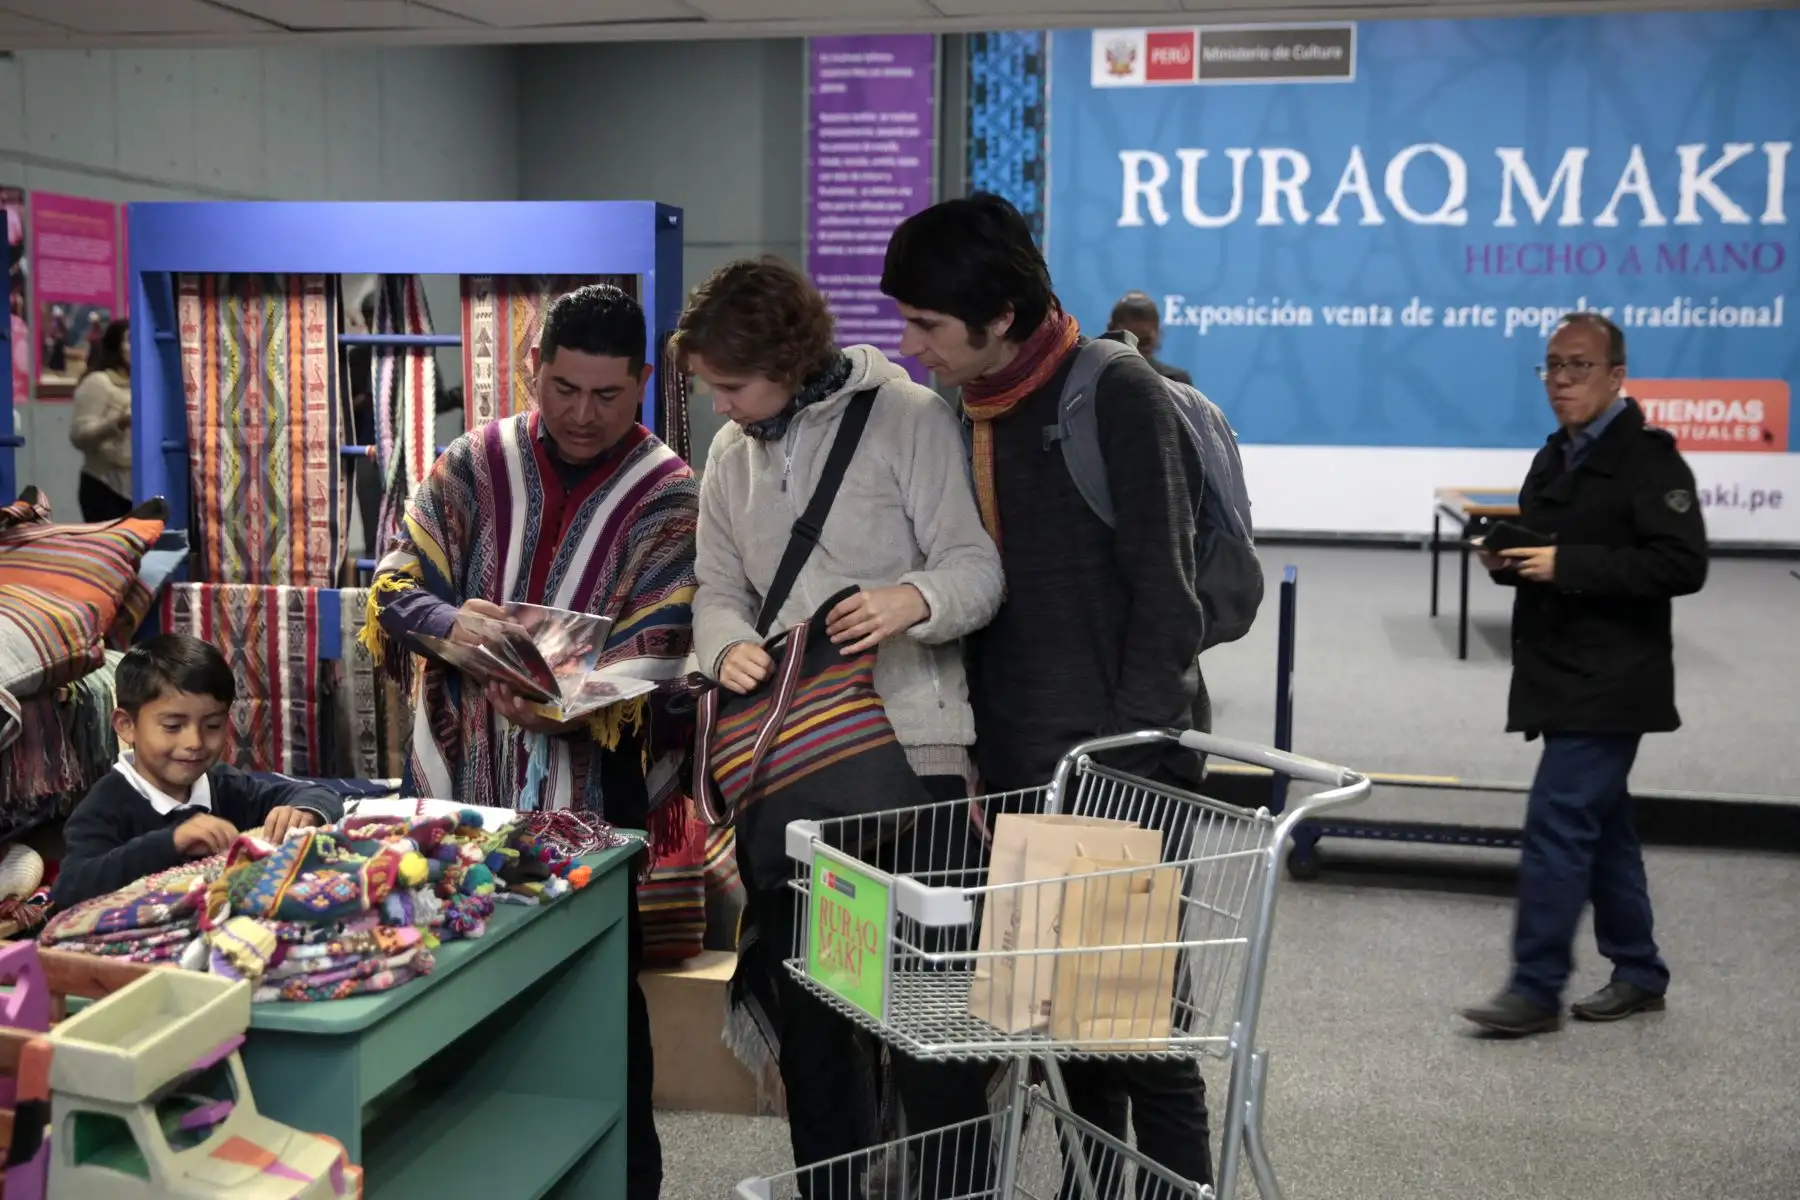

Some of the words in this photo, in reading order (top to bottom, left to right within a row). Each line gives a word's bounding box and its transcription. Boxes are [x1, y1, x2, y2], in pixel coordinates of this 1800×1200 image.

[1151, 43, 1191, 65] PERÚ
[1203, 44, 1270, 62] Ministerio
[1273, 43, 1294, 61] de
[1295, 42, 1342, 61] Cultura
[1117, 143, 1468, 228] RURAQ
[1494, 141, 1791, 228] MAKI
[1465, 241, 1607, 276] HECHO
[1617, 244, 1643, 275] A
[1656, 240, 1786, 274] MANO
[1164, 295, 1313, 335] Exposición
[1322, 303, 1393, 327] venta
[1401, 296, 1434, 326] de
[1443, 302, 1497, 327] arte
[1623, 294, 1784, 328] tradicional
[1642, 398, 1764, 422] TIENDAS
[820, 895, 878, 955] RURAQ
[818, 922, 863, 981] MAKI
